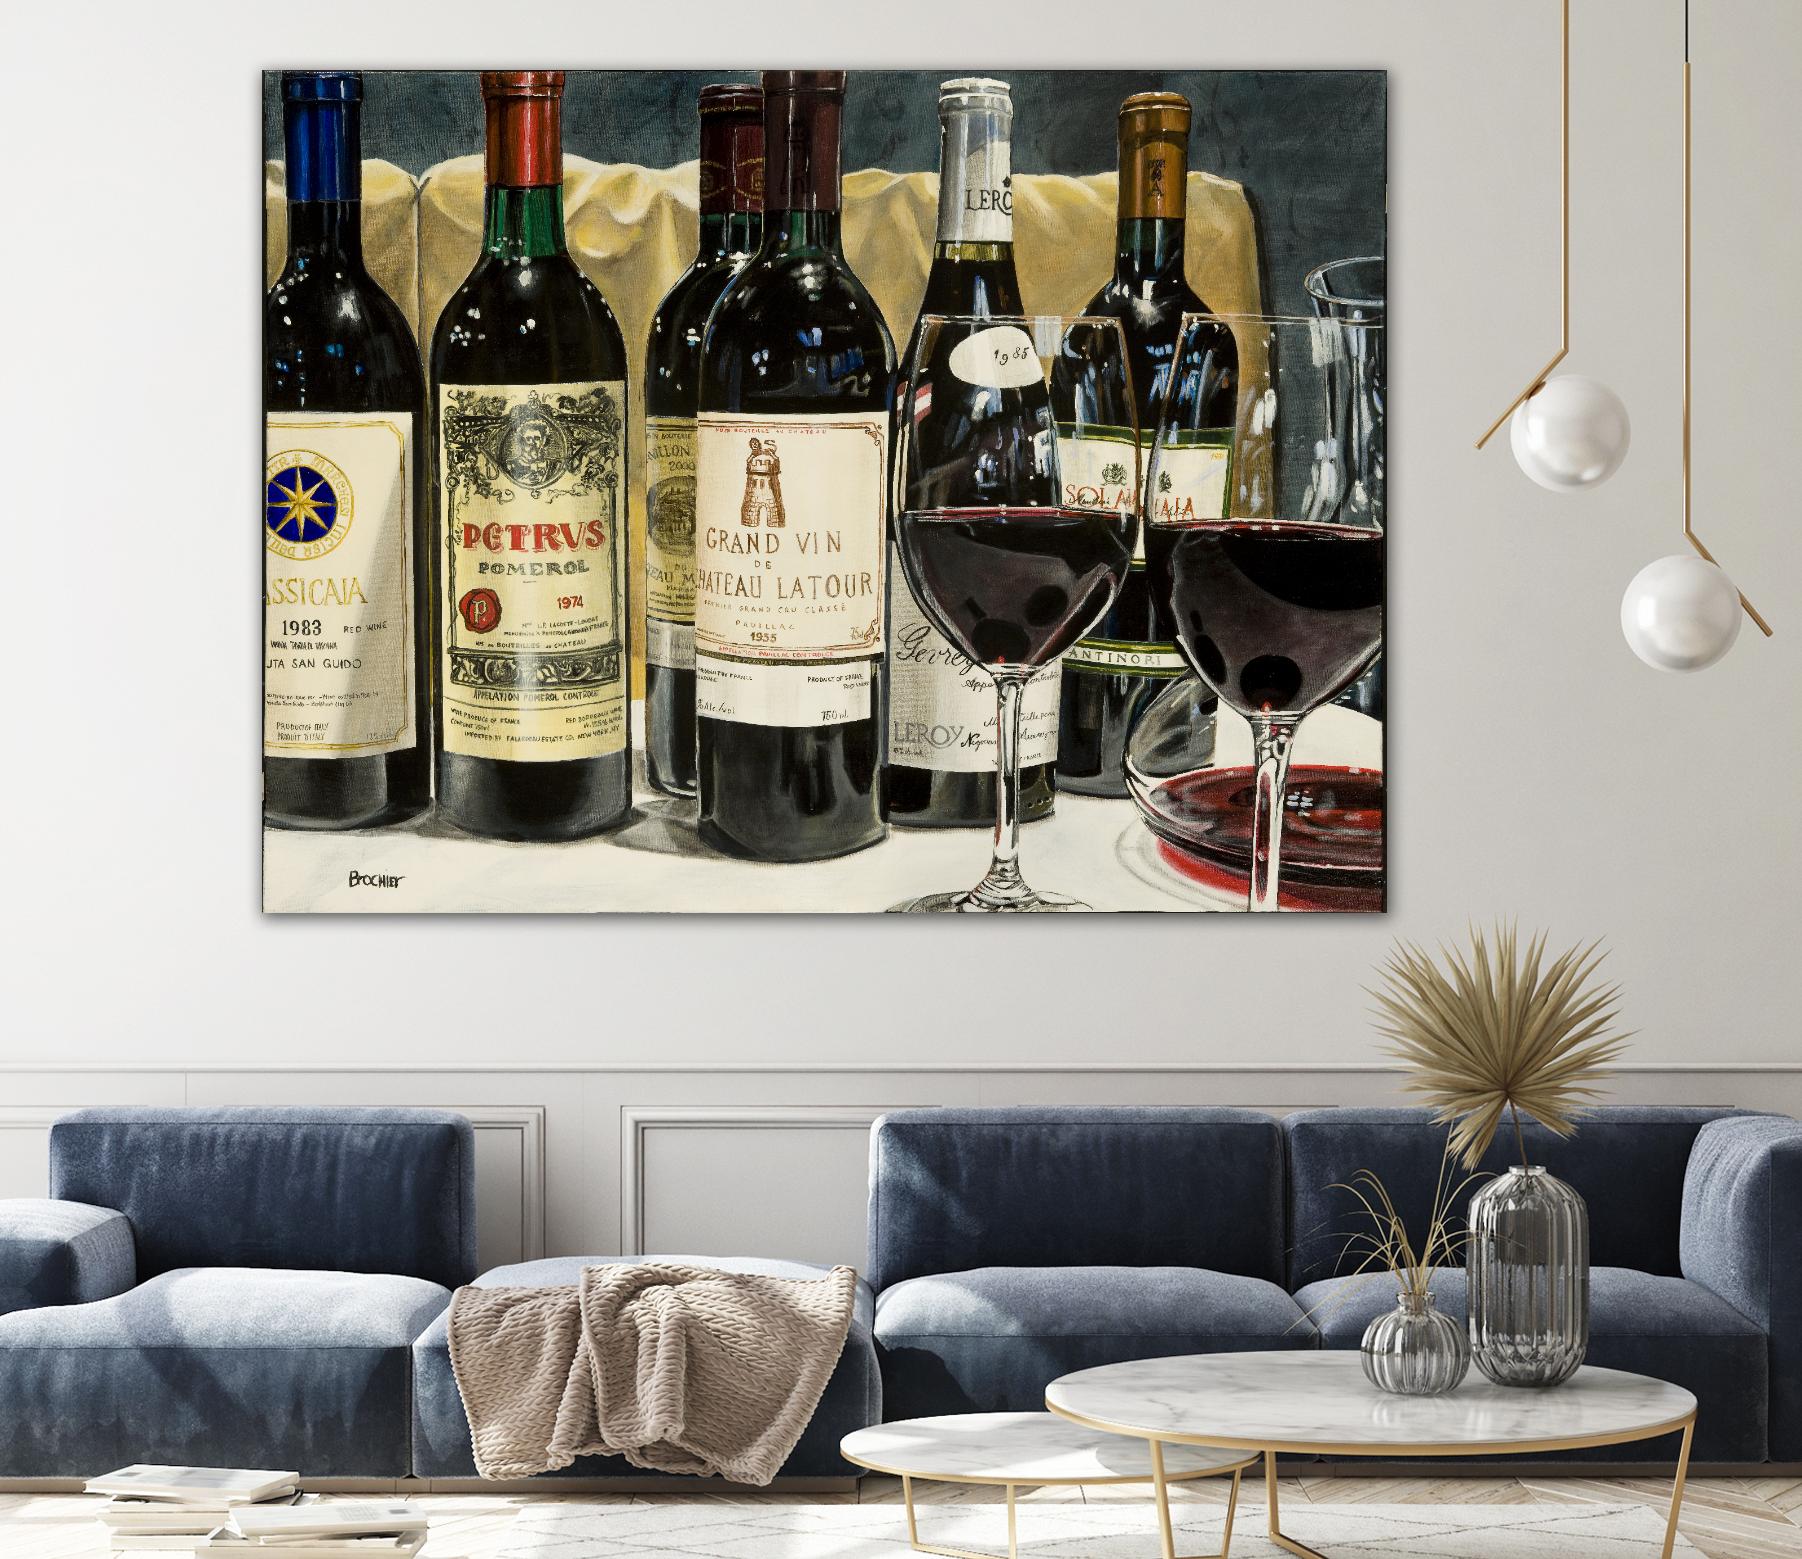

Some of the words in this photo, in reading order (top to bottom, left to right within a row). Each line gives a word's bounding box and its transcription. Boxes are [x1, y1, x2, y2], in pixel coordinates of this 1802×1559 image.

[994, 346, 1029, 366] 1985
[706, 527, 780, 554] GRAND
[796, 530, 841, 555] VIN
[478, 559, 591, 577] POMEROL
[754, 560, 772, 570] DE
[695, 569, 762, 599] HATEAU
[778, 571, 873, 600] LATOUR
[556, 595, 584, 610] 1974
[739, 605, 771, 613] GRAND
[282, 619, 322, 636] 1983
[344, 625, 361, 634] RED
[292, 658, 315, 669] SAN
[323, 658, 362, 669] GUIDO
[1068, 645, 1161, 666] ANTINORI
[893, 721, 965, 749] LEROY
